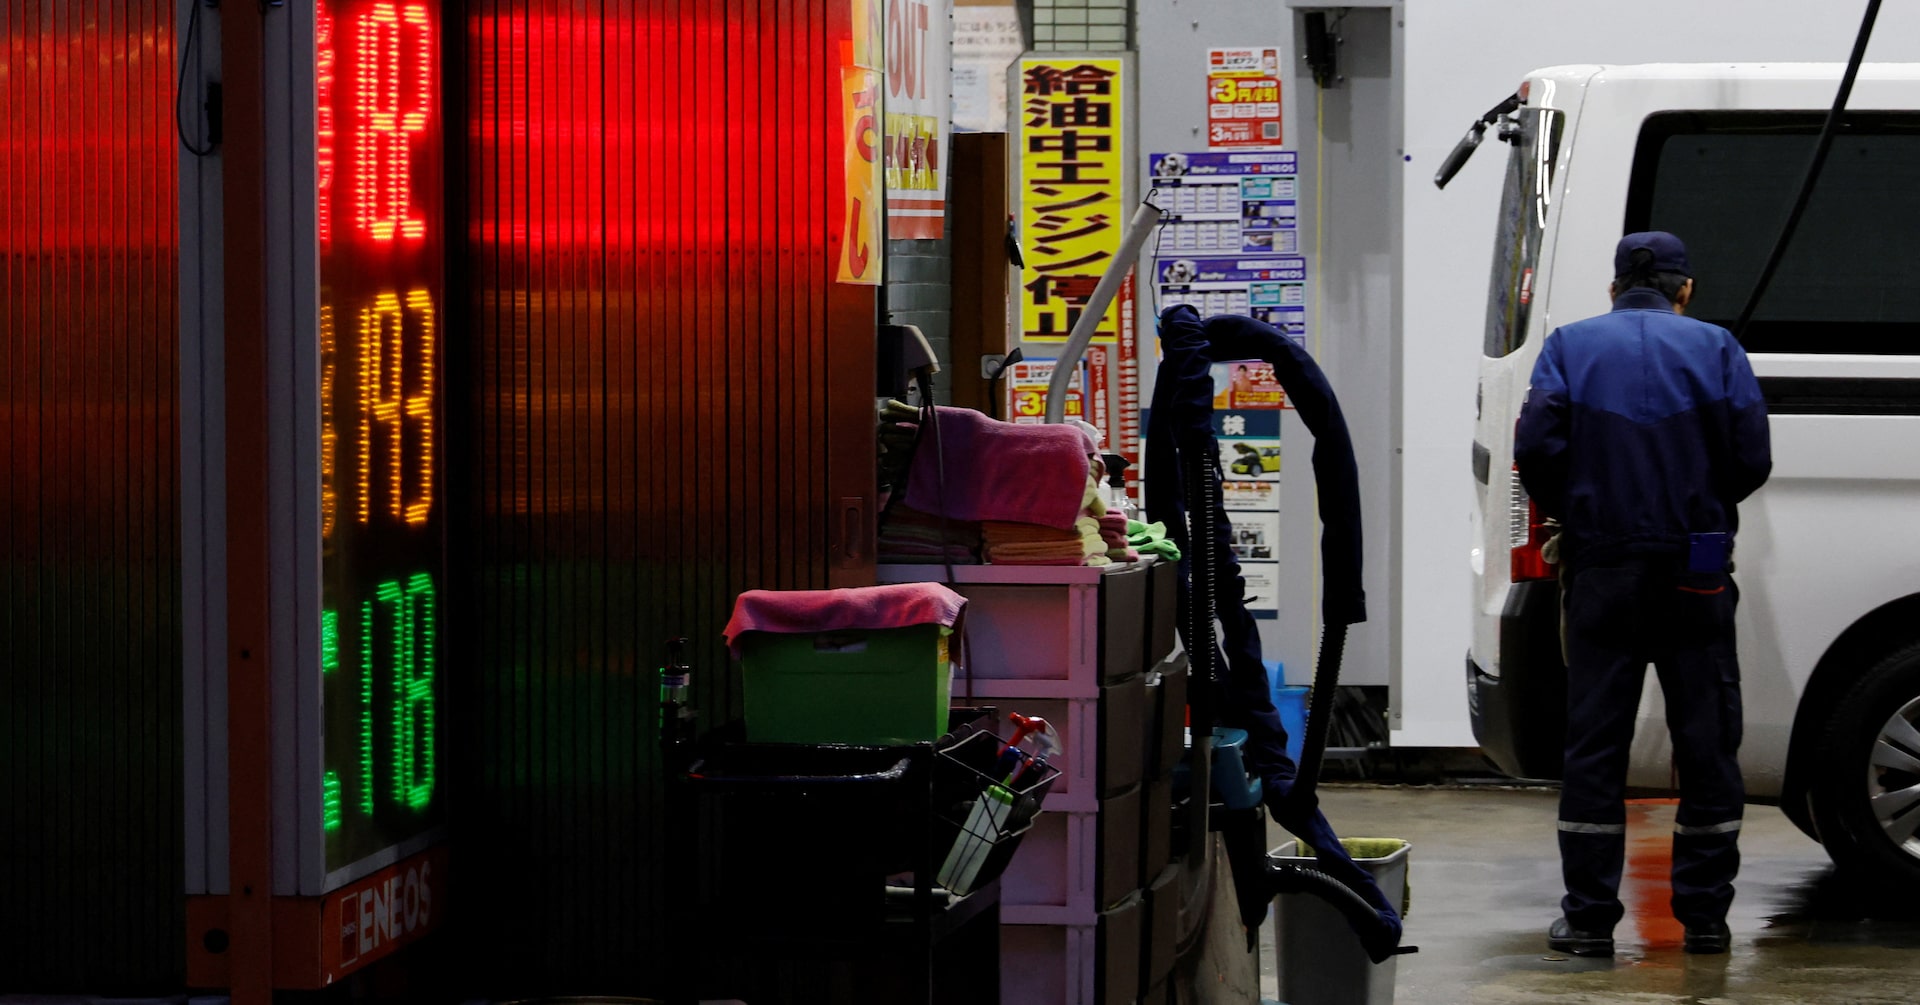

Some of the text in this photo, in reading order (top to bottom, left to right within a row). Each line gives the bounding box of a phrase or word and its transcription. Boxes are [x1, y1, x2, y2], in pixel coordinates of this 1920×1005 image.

[355, 3, 430, 242] 182
[888, 0, 928, 99] OUT
[1024, 64, 1117, 337] 給油中エンジン停止
[1261, 164, 1296, 173] ENEOS
[1269, 270, 1304, 279] ENEOS
[357, 289, 434, 524] 193
[358, 572, 435, 816] 178
[360, 860, 432, 956] ENEOS
